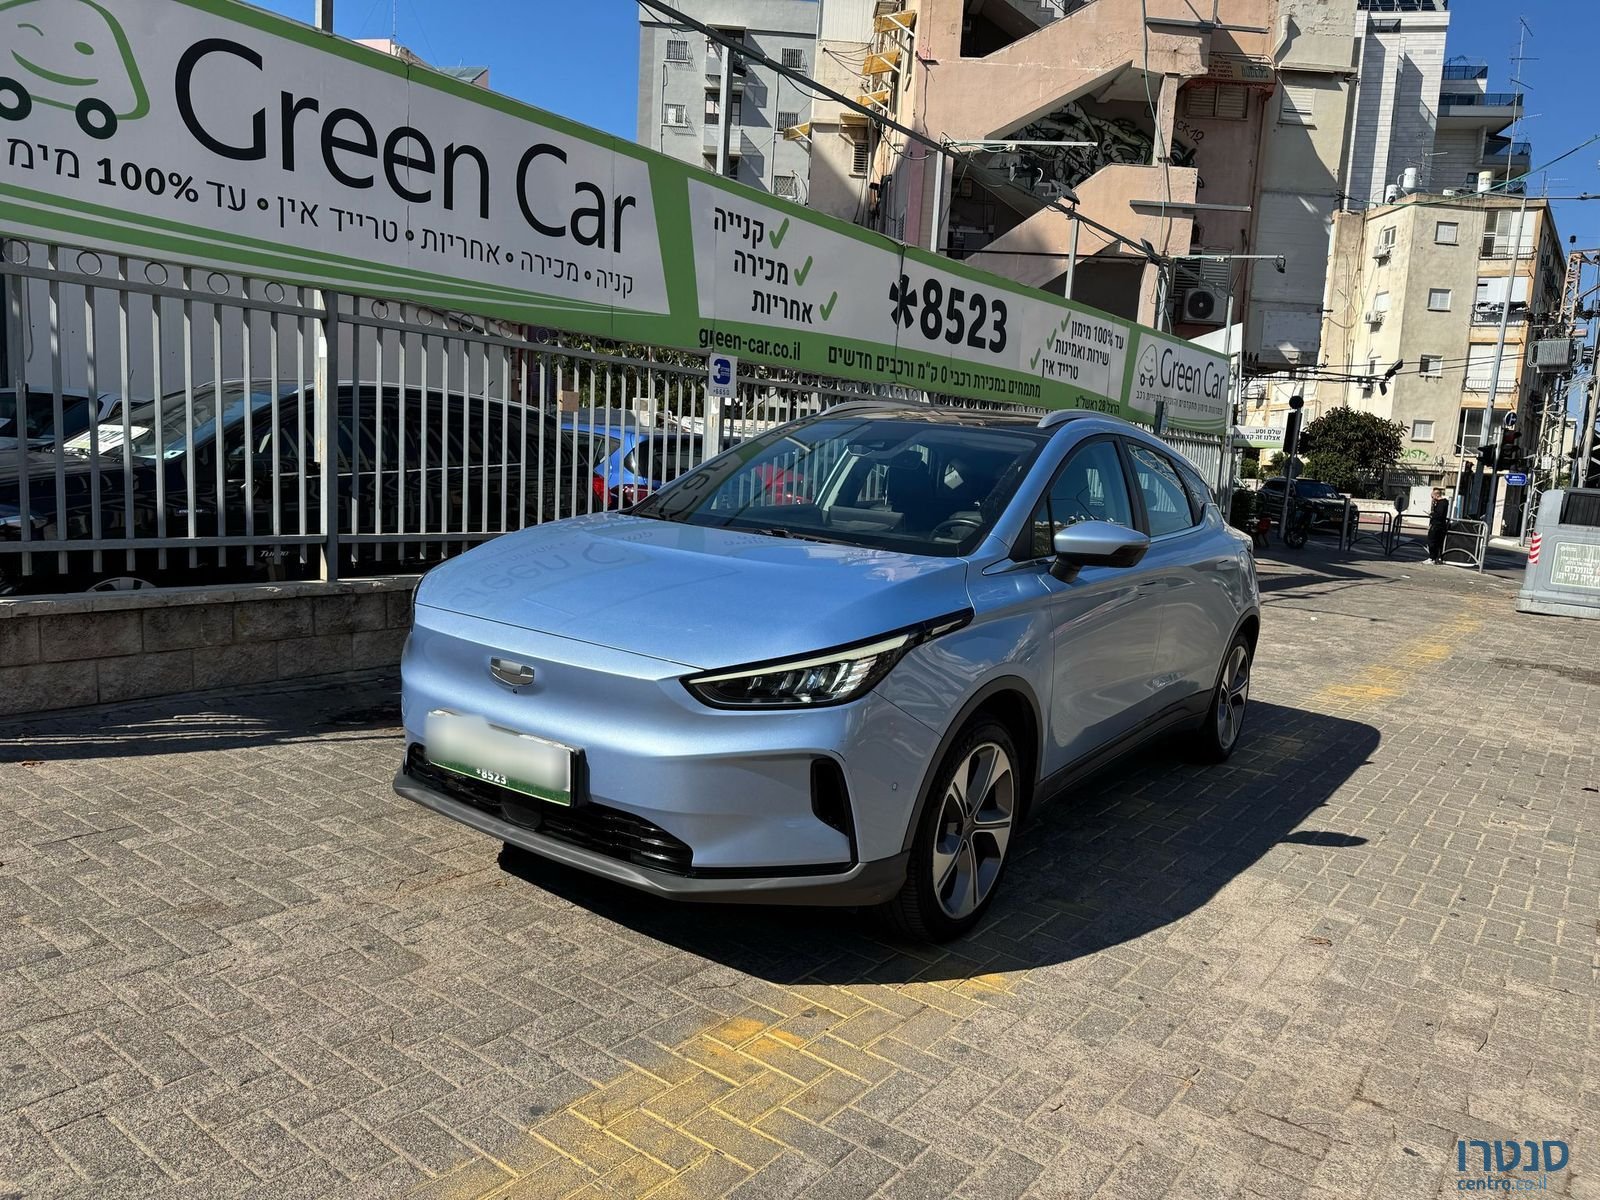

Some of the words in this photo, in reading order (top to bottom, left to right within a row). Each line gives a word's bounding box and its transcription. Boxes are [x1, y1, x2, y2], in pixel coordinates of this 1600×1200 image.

[175, 38, 489, 219] Green
[516, 143, 636, 253] Car
[96, 158, 199, 203] 100%
[206, 180, 246, 212] עד
[277, 196, 319, 228] אין
[329, 207, 397, 242] טרייד
[714, 207, 764, 249] קנייה
[421, 229, 500, 265] אחריות
[521, 251, 578, 282] מכירה
[734, 250, 788, 285] מכירה
[597, 269, 633, 299] קניה
[752, 290, 813, 324] אחריות
[1071, 320, 1091, 339] מימון
[1093, 326, 1113, 344] 100%
[1114, 335, 1124, 350] עד
[699, 327, 800, 361] green-car.co.il
[829, 345, 872, 370] חדשים
[1055, 339, 1086, 361] ואמינות
[1086, 347, 1110, 366] שירות
[876, 353, 914, 377] ורכבים
[940, 366, 947, 383] 0
[1042, 358, 1055, 378] אין
[1057, 364, 1079, 380] טרייד
[1160, 348, 1202, 395] Green
[1203, 361, 1225, 400] Car
[950, 372, 971, 387] רכבי
[973, 375, 1006, 393] במכירת
[1008, 381, 1041, 398] מתמחים
